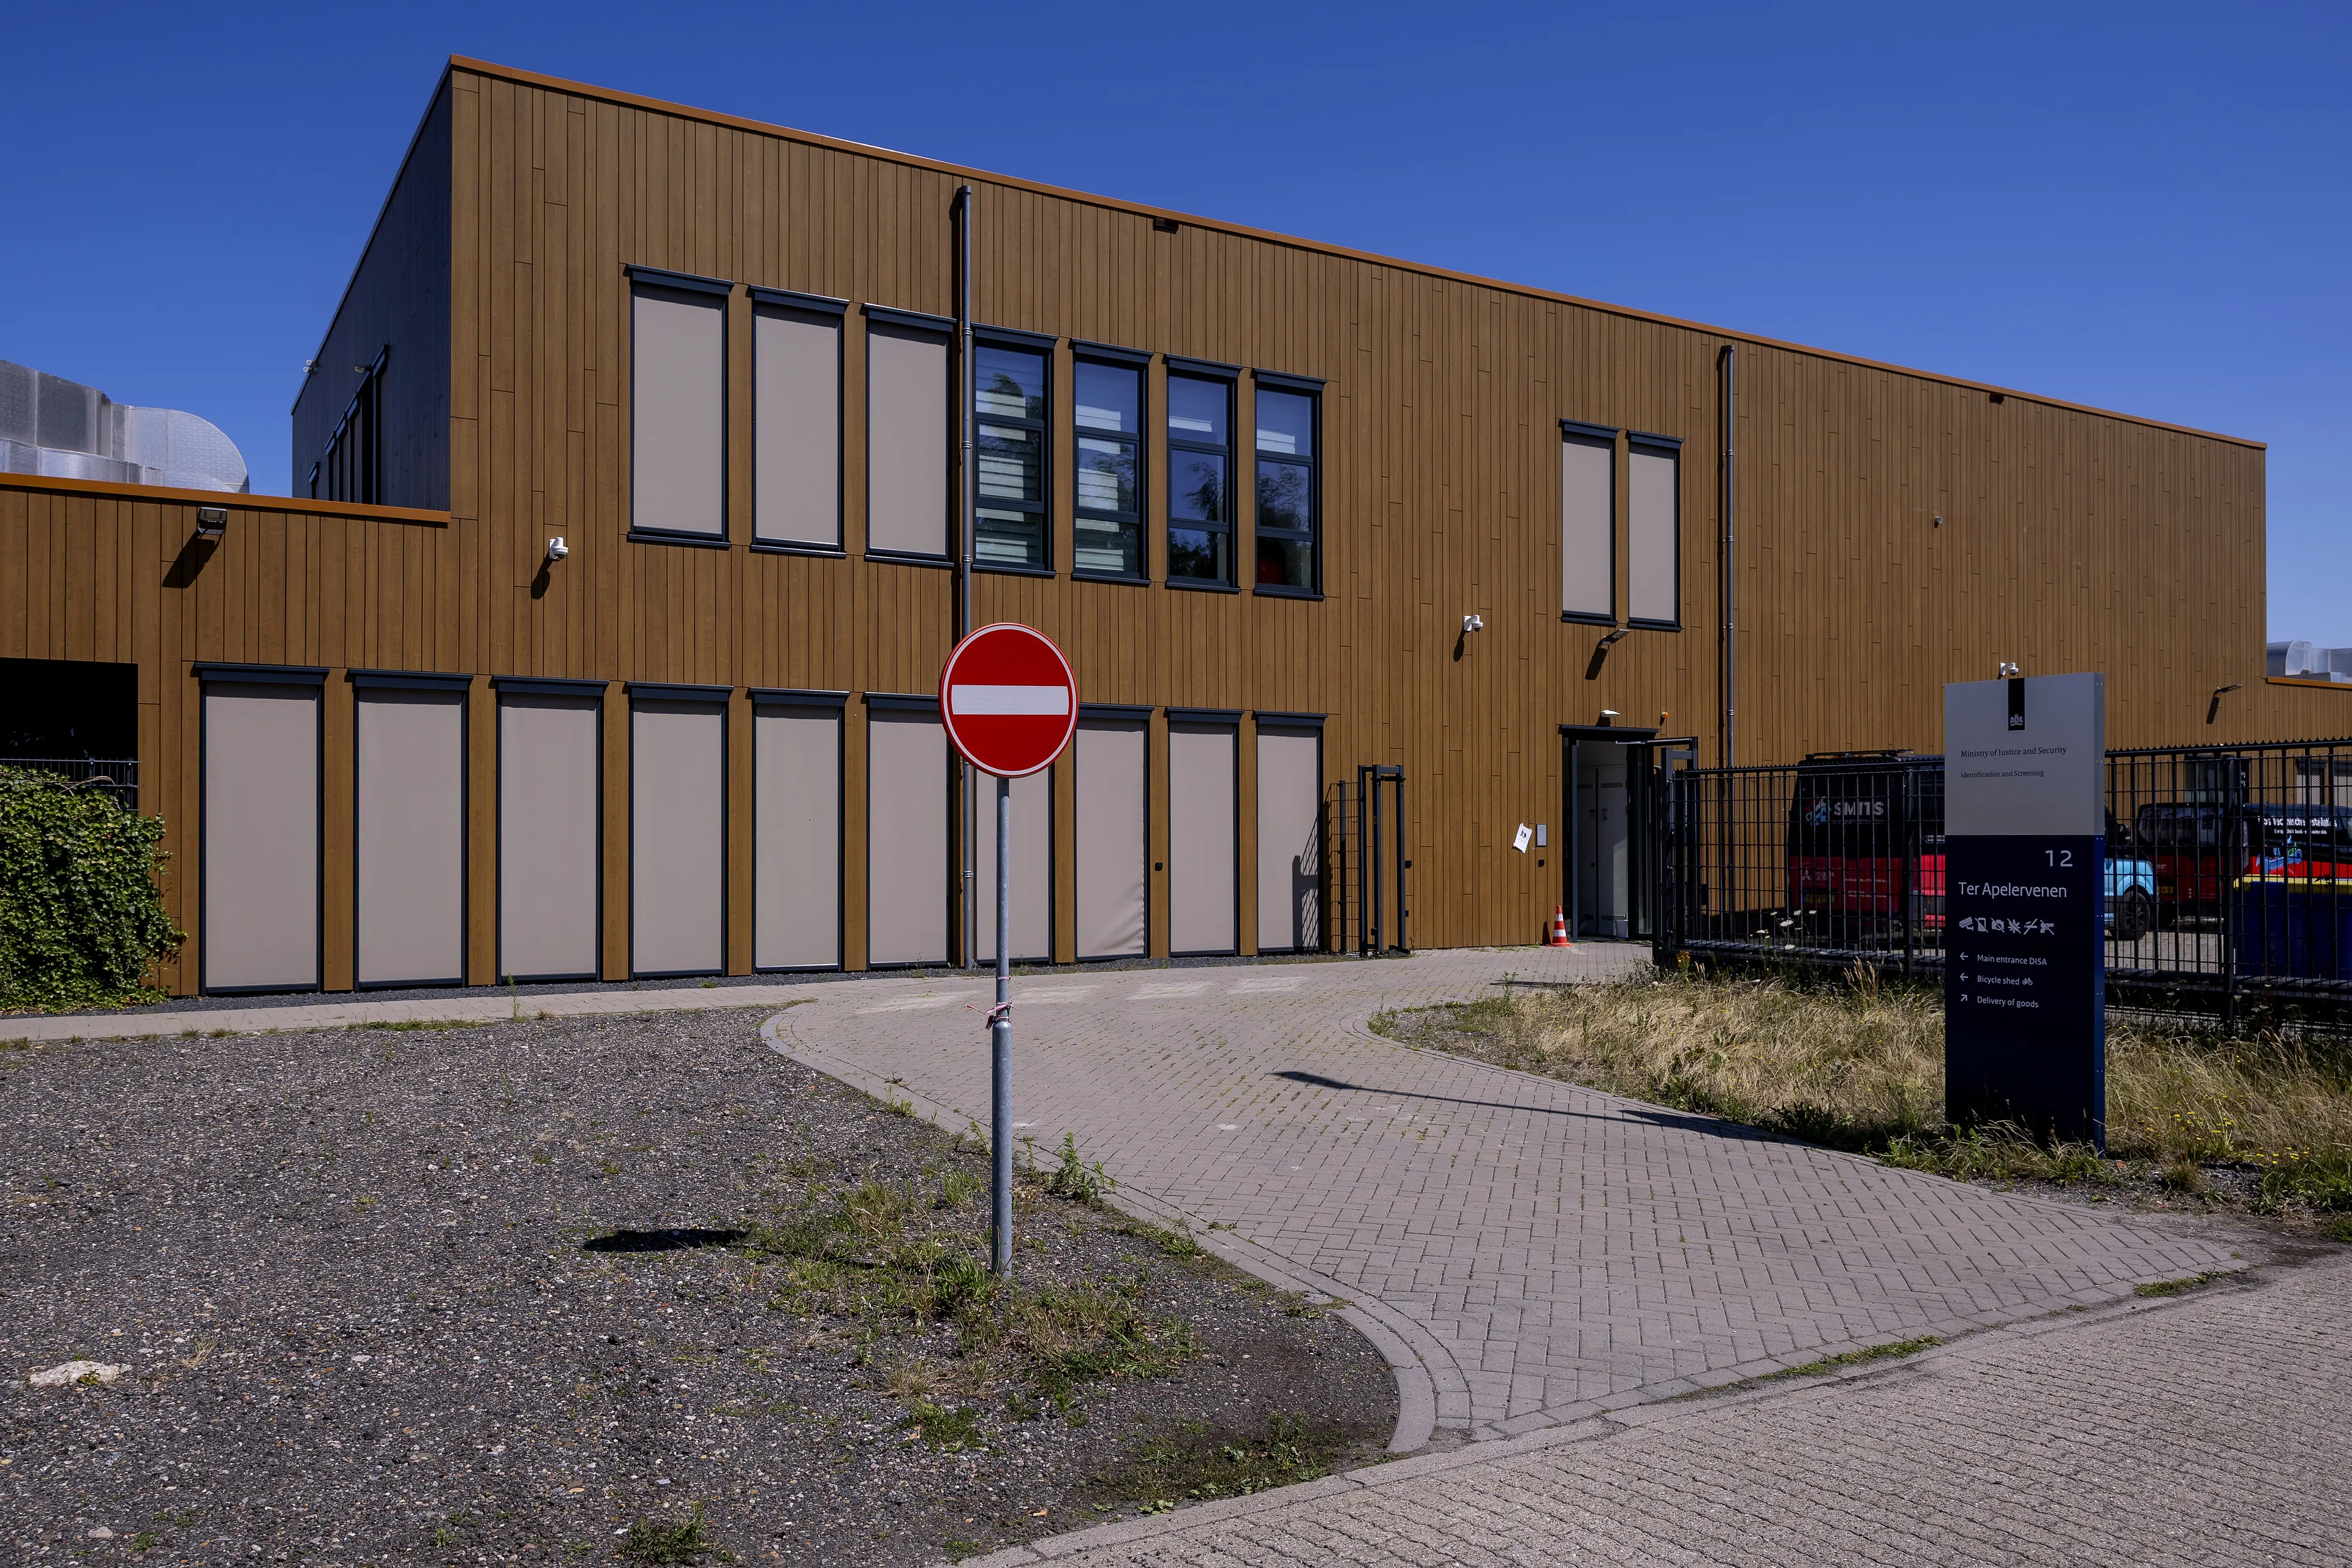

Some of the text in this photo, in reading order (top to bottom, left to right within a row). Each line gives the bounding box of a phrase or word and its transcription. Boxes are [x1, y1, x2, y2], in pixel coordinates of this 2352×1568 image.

[1961, 745, 2067, 759] Ministry of Justice and Security
[2014, 769, 2045, 778] Screening
[2045, 850, 2073, 867] 12
[1958, 881, 2067, 899] Ter Apelervenen
[1977, 954, 1995, 963] Main
[2029, 957, 2047, 966] DISA
[1977, 975, 2020, 986] Bicycle shed
[1977, 996, 2006, 1007] Delivery
[2016, 1000, 2039, 1009] goods
